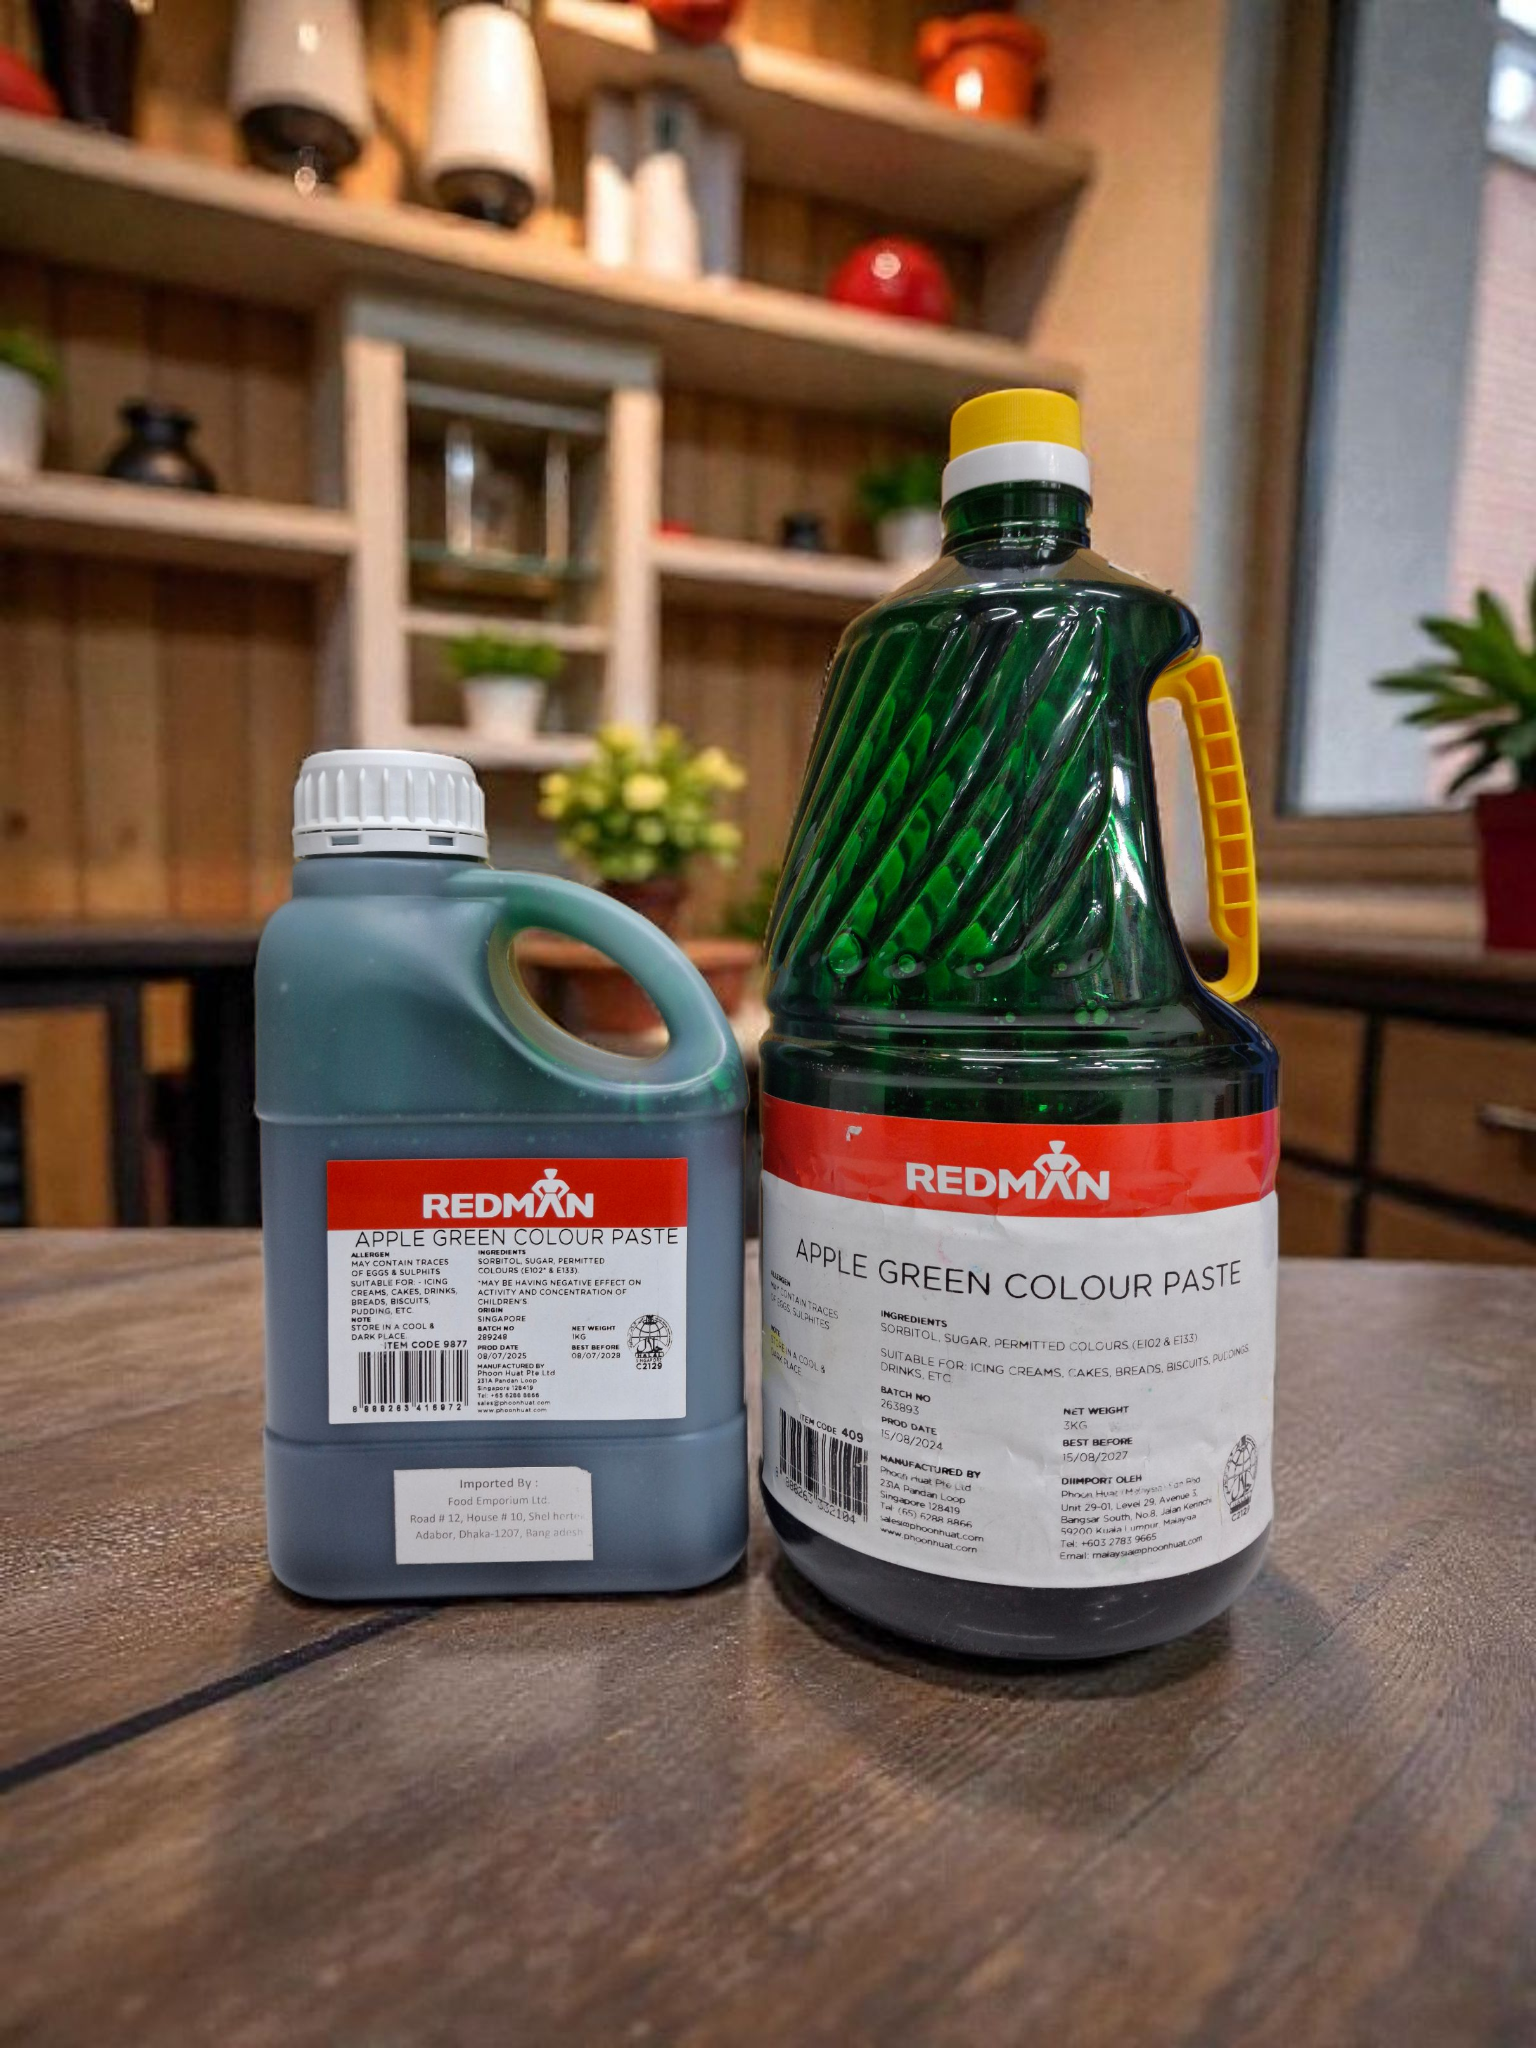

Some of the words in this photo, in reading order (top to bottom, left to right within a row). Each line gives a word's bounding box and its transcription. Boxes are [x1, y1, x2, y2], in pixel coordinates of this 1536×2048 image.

[906, 1161, 1109, 1200] REDMAN
[423, 1193, 594, 1218] REDMAN
[355, 1229, 426, 1248] APPLE
[433, 1229, 505, 1246] GREEN
[514, 1228, 603, 1246] COLOUR
[612, 1228, 678, 1245] PASTE
[796, 1238, 867, 1279] APPLE
[879, 1258, 990, 1296] GREEN
[1005, 1272, 1152, 1301] COLOUR
[1164, 1259, 1241, 1294] PASTE
[391, 1288, 421, 1296] CAKES,
[808, 1301, 838, 1319] TRACES
[881, 1310, 947, 1328] INGREDIENTS
[443, 1340, 467, 1348] 9877
[994, 1338, 1065, 1351] PERMITTED
[1069, 1341, 1129, 1351] COLOURS
[1163, 1336, 1170, 1346] &
[881, 1348, 934, 1367] SUITABLE
[971, 1362, 1004, 1374] ICING
[881, 1386, 912, 1399] BATCH
[916, 1393, 931, 1403] NO
[881, 1399, 919, 1415] 263893
[1088, 1406, 1129, 1415] WEIGHT
[800, 1413, 814, 1426] ITEM
[816, 1420, 837, 1435] CODE
[842, 1428, 863, 1443] 409
[881, 1416, 907, 1429] PROD
[911, 1423, 937, 1436] DATE
[1063, 1421, 1088, 1430] 3KG
[1063, 1439, 1089, 1447] BEST
[1092, 1437, 1133, 1446] BEFORE
[881, 1454, 963, 1477] MANUFACTURED
[967, 1470, 981, 1479] BY
[460, 1478, 514, 1491] Imported
[517, 1479, 531, 1489] By
[1061, 1477, 1112, 1485] DIIMPORT
[1116, 1475, 1142, 1484] OLEH
[448, 1497, 473, 1506] Food
[476, 1496, 528, 1507] Emporium
[904, 1485, 938, 1499] Pandan
[941, 1492, 965, 1504] Loop
[880, 1491, 925, 1509] Singapore
[928, 1501, 960, 1515] 128419
[1061, 1503, 1081, 1512] Unit
[1116, 1499, 1141, 1510] Level
[410, 1514, 435, 1523] Road
[439, 1514, 445, 1523] #
[449, 1514, 463, 1523] 12,
[467, 1514, 498, 1522] House
[501, 1513, 507, 1522] #
[511, 1512, 526, 1522] 10,
[1061, 1516, 1100, 1525] Bangsar
[416, 1530, 455, 1541] Adabor,
[1109, 1536, 1132, 1545] 2783
